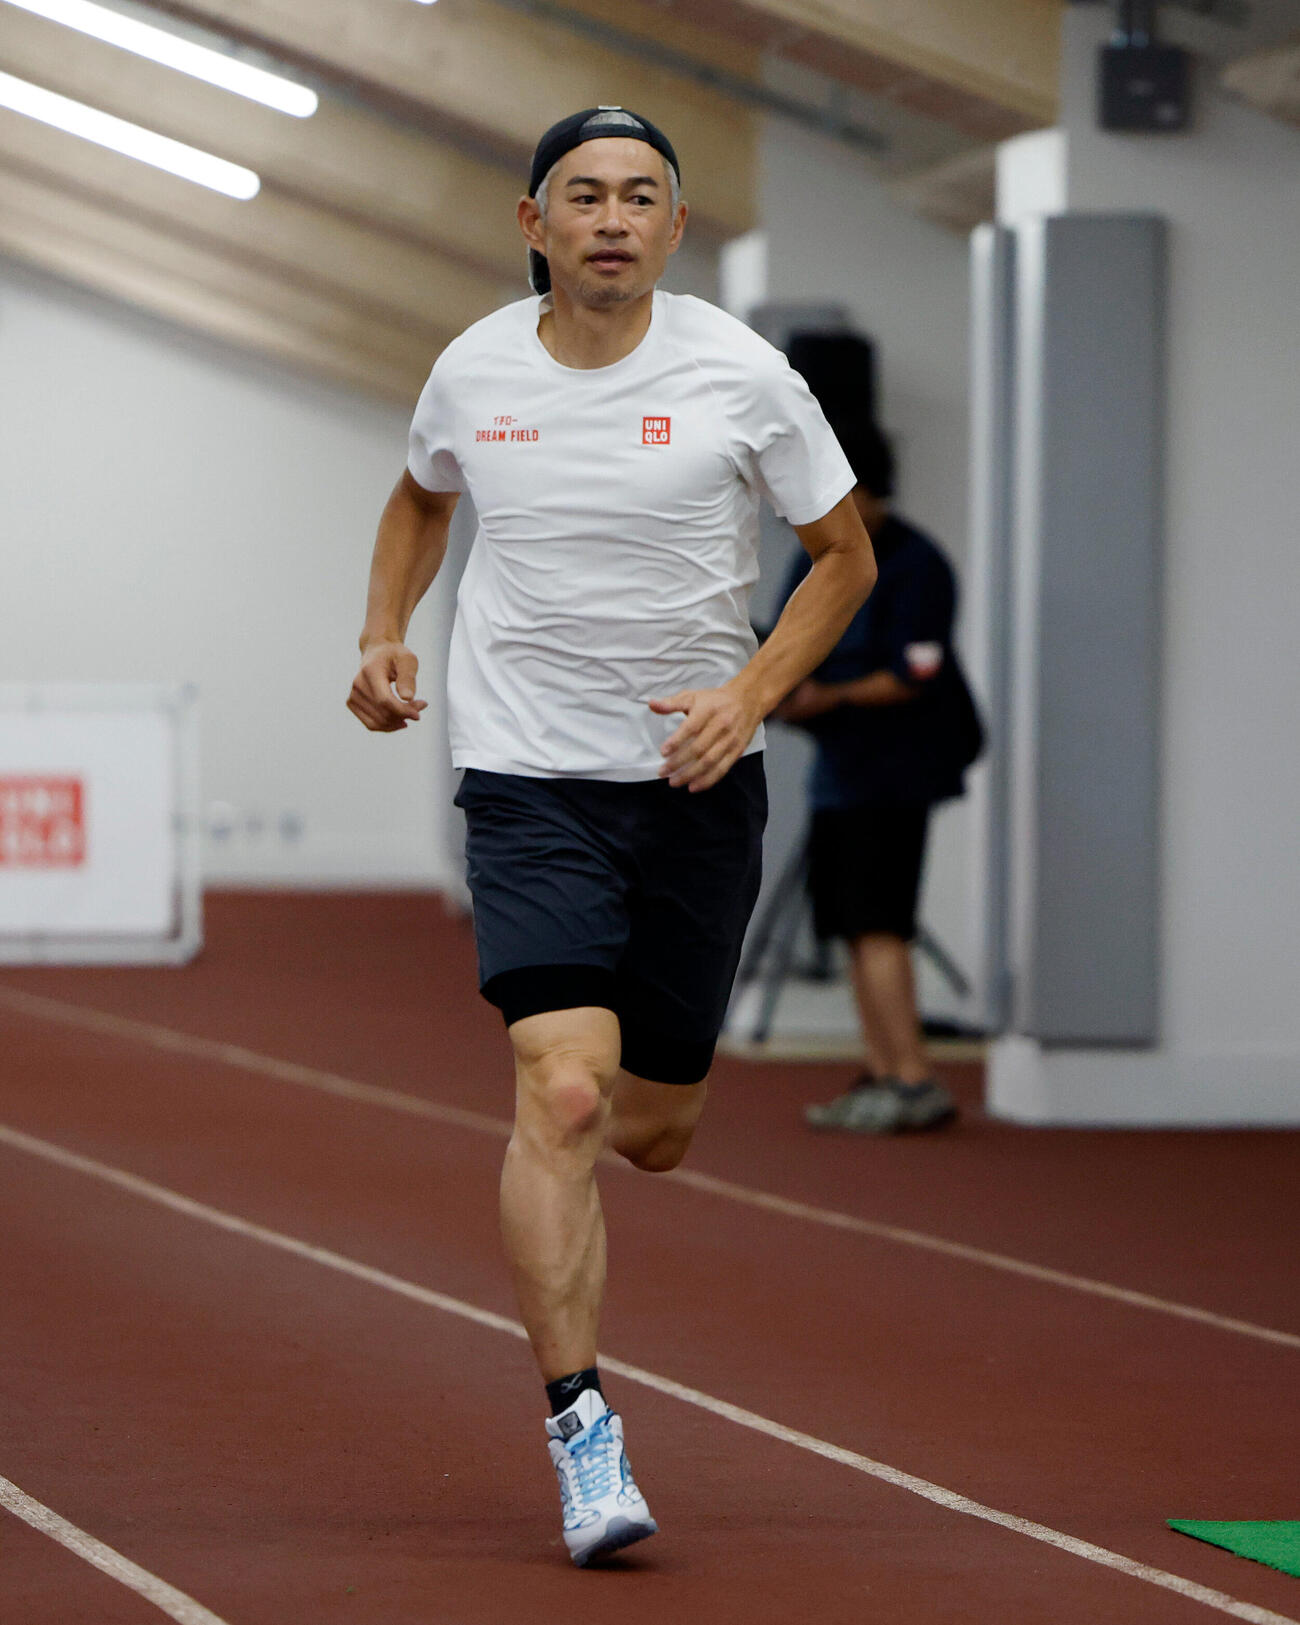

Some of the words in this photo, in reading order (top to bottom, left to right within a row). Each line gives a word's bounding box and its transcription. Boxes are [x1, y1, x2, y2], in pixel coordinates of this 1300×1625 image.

[645, 419, 666, 430] UNI
[475, 429, 506, 442] DREAM
[510, 429, 539, 441] FIELD
[645, 431, 668, 443] QLO
